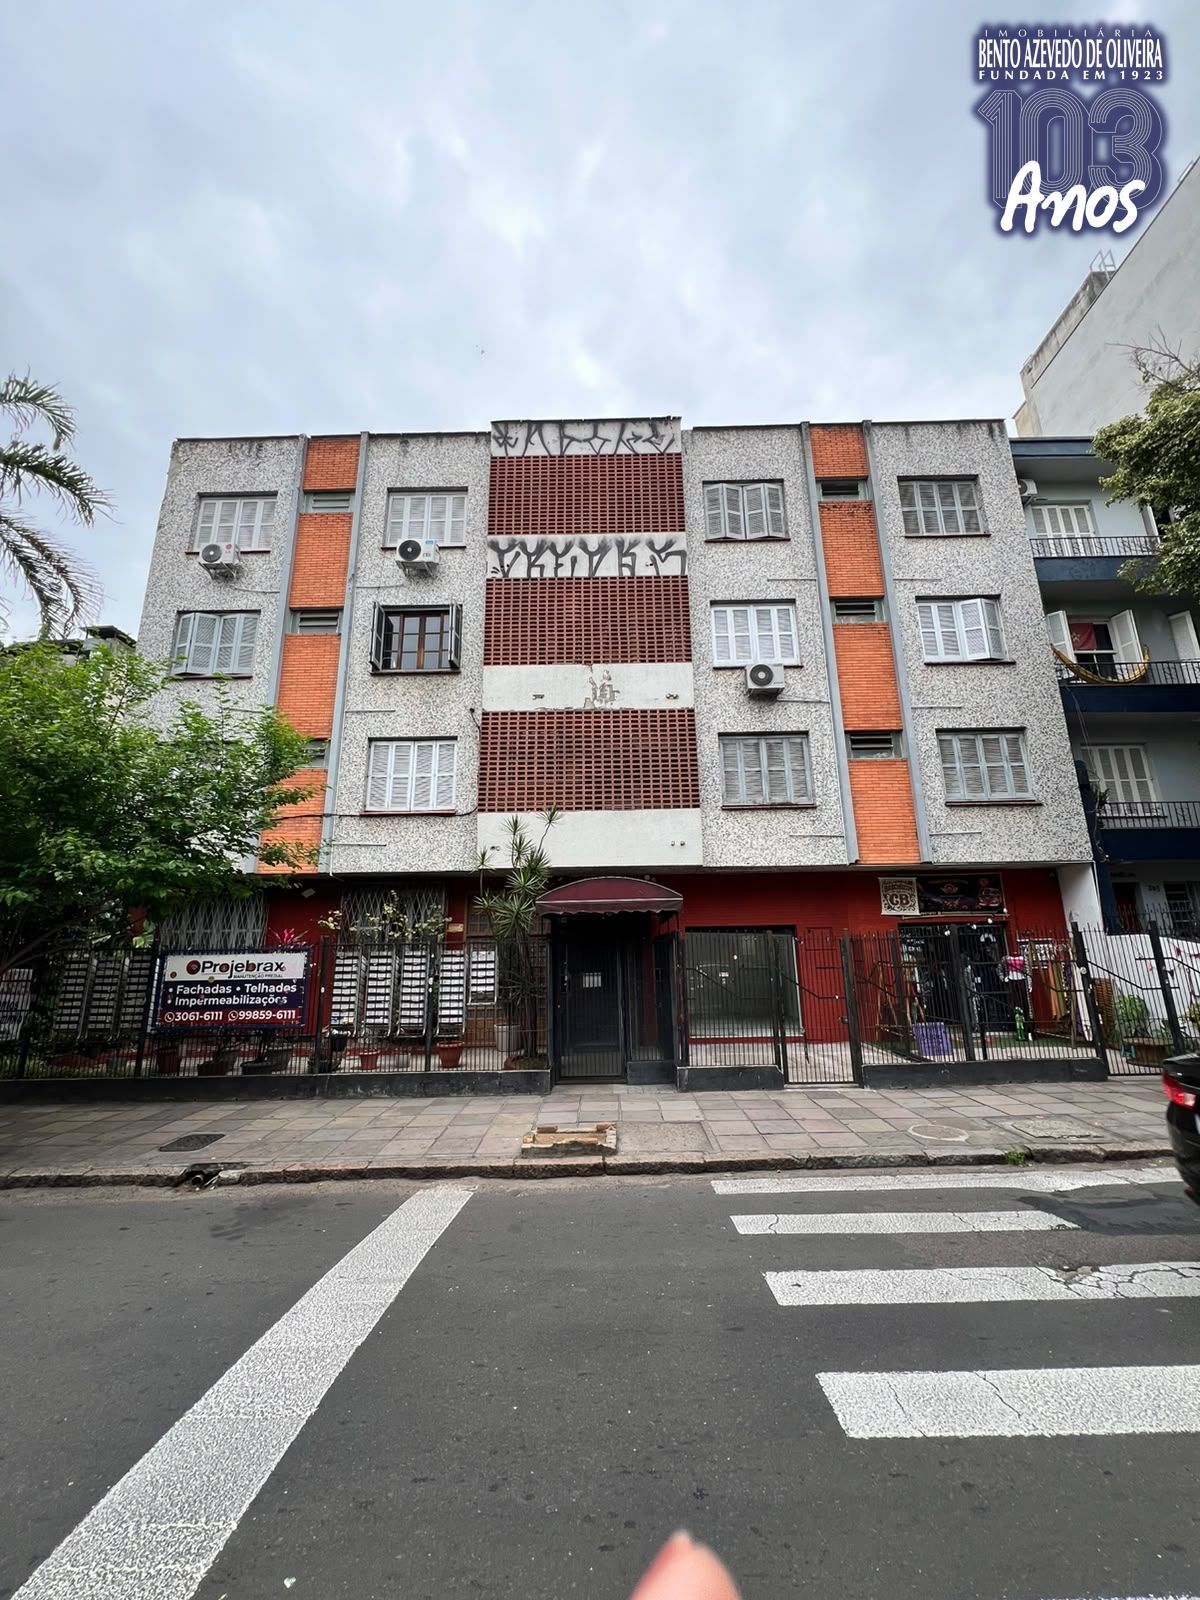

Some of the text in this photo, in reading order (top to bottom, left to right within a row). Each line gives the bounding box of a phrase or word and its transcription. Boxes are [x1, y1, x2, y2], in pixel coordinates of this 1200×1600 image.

[201, 959, 284, 979] Projebrax
[176, 982, 297, 995] Fachadas Telhados
[175, 995, 288, 1007] Impermeabilizações
[174, 1009, 296, 1022] 3061-6111 99859-6111
